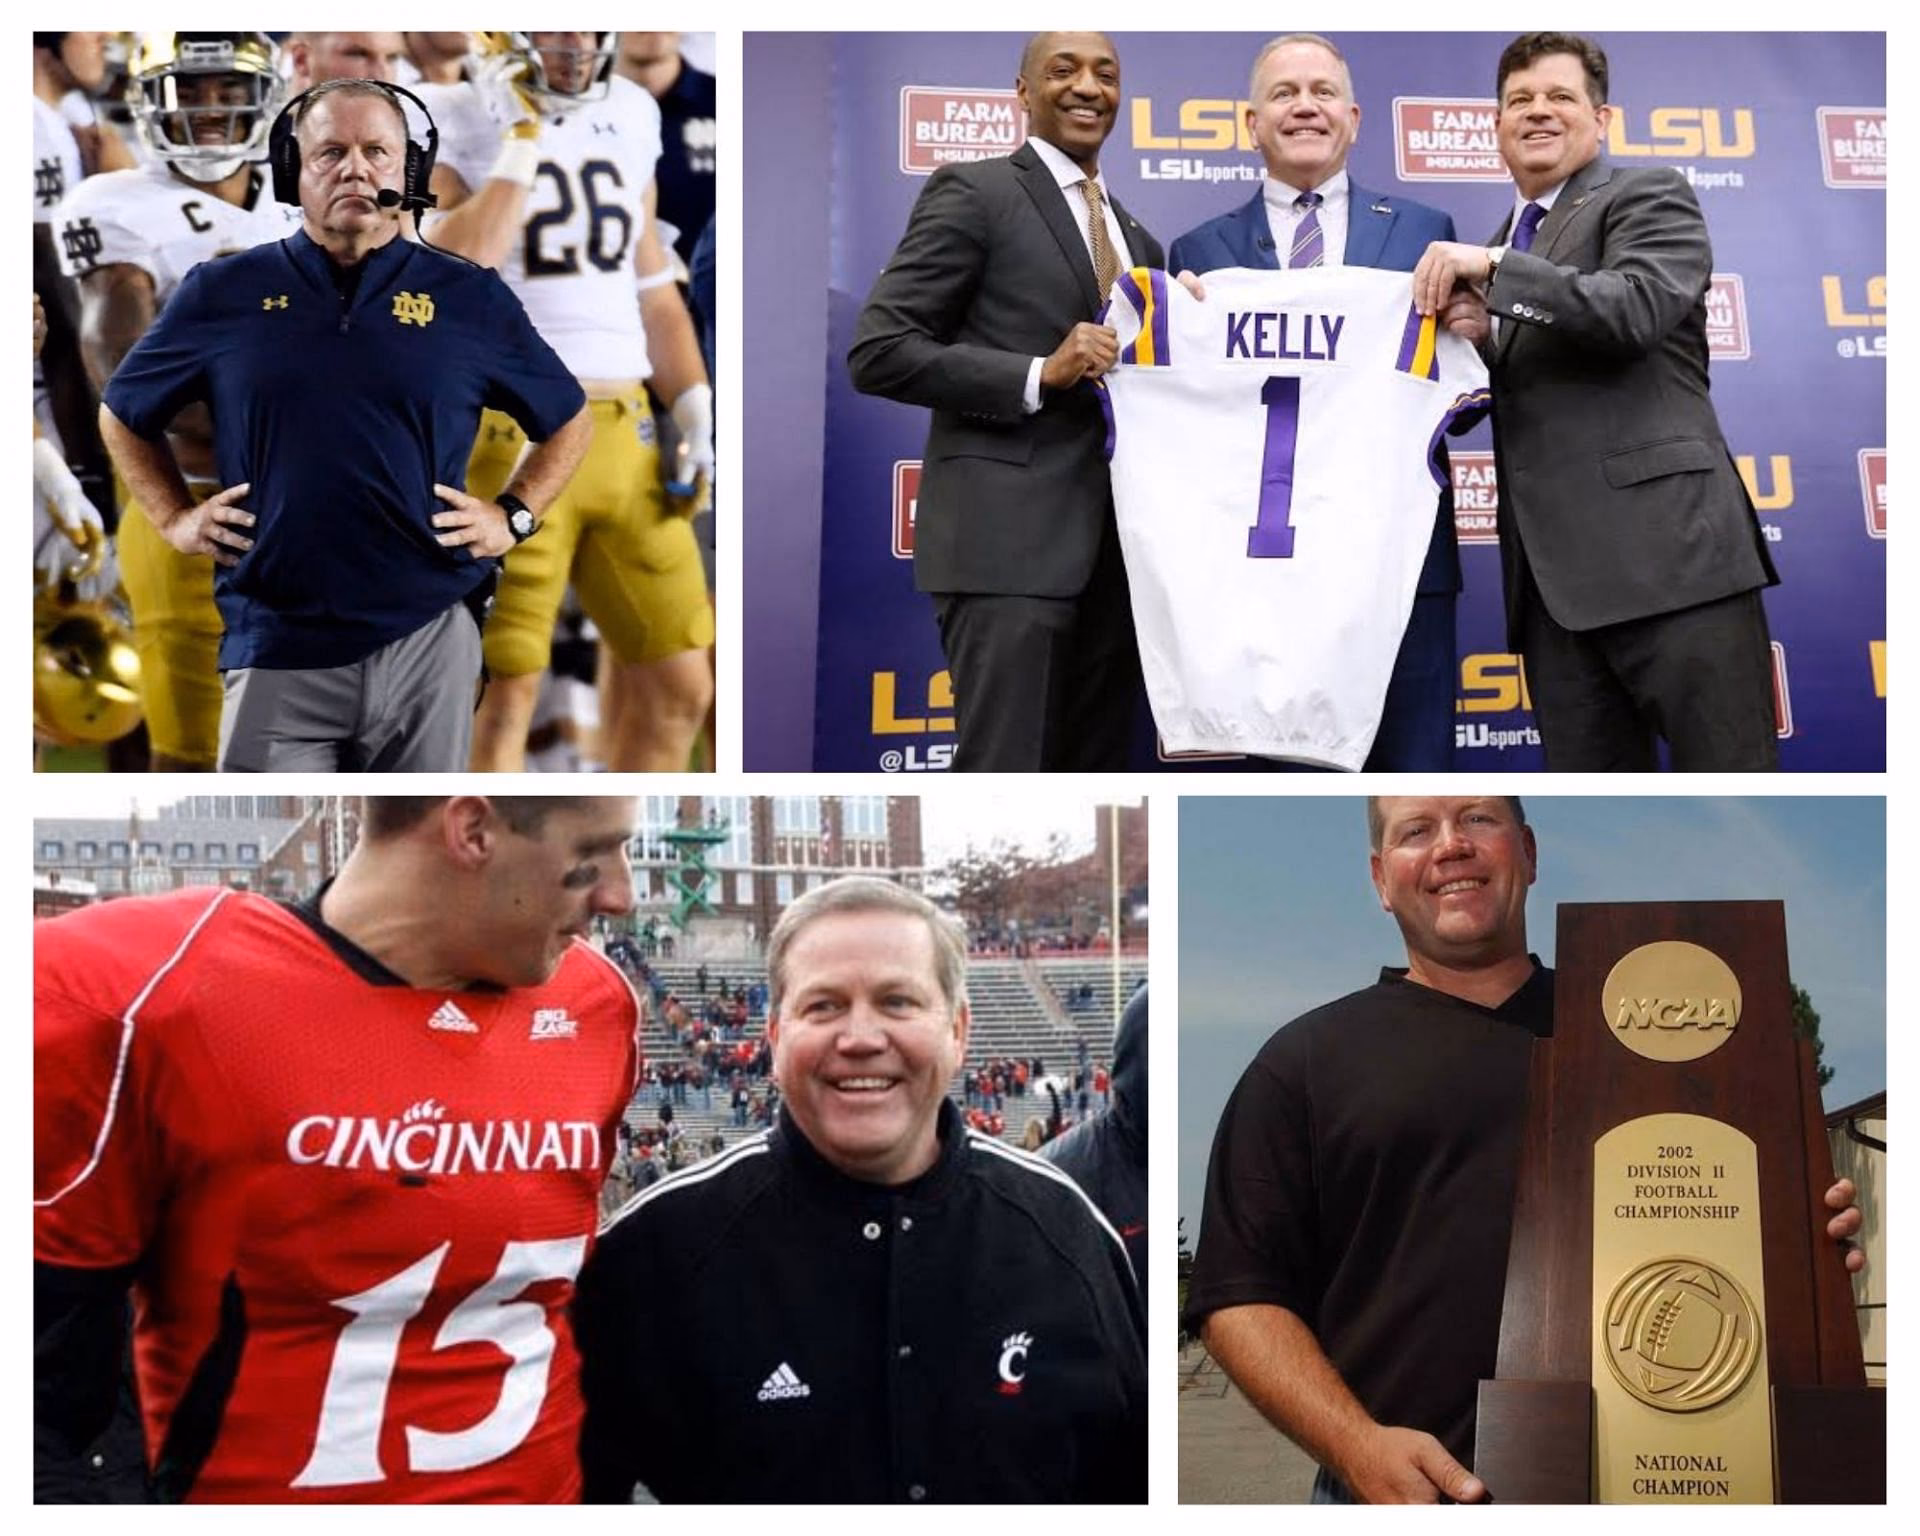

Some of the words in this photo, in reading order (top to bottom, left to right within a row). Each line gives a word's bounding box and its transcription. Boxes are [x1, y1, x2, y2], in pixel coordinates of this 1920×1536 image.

[944, 101, 1015, 122] FARM
[1432, 111, 1497, 131] FARM
[915, 121, 1016, 144] BUREAU
[1408, 129, 1498, 151] BUREAU
[1608, 106, 1756, 158] LSU
[181, 201, 213, 233] C
[523, 159, 632, 276] 26
[1226, 312, 1345, 361] KELLY
[1247, 375, 1300, 558] 1
[880, 743, 959, 772] @LS
[1616, 997, 1738, 1030] NCAA
[1657, 1145, 1694, 1159] 2002
[1627, 1164, 1701, 1178] DIVISION
[1713, 1164, 1724, 1178] II
[1635, 1184, 1718, 1199] FOOTBALL
[1614, 1204, 1740, 1219] CHAMPIONSHIP
[290, 1234, 588, 1488] 15
[1634, 1454, 1728, 1472] NATIONAL
[1632, 1478, 1730, 1497] CHAMPION
